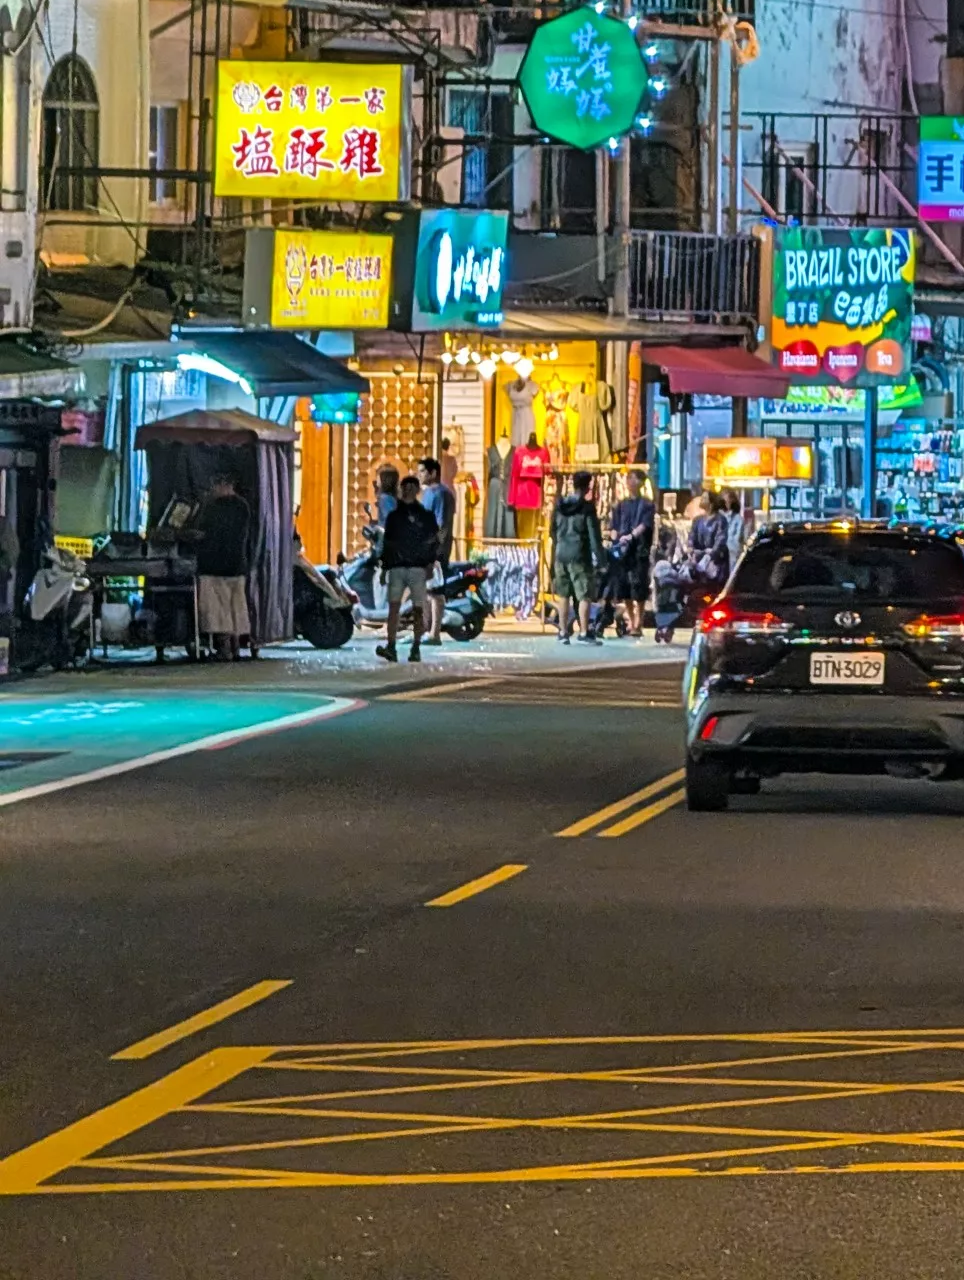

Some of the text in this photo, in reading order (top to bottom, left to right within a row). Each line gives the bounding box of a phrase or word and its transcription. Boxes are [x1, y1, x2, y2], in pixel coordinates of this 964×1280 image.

[263, 84, 386, 115] 台灣第一家
[232, 124, 384, 179] 塩酥雞
[784, 246, 902, 290] BRAZIL STORE
[812, 659, 882, 679] BTN-3029
